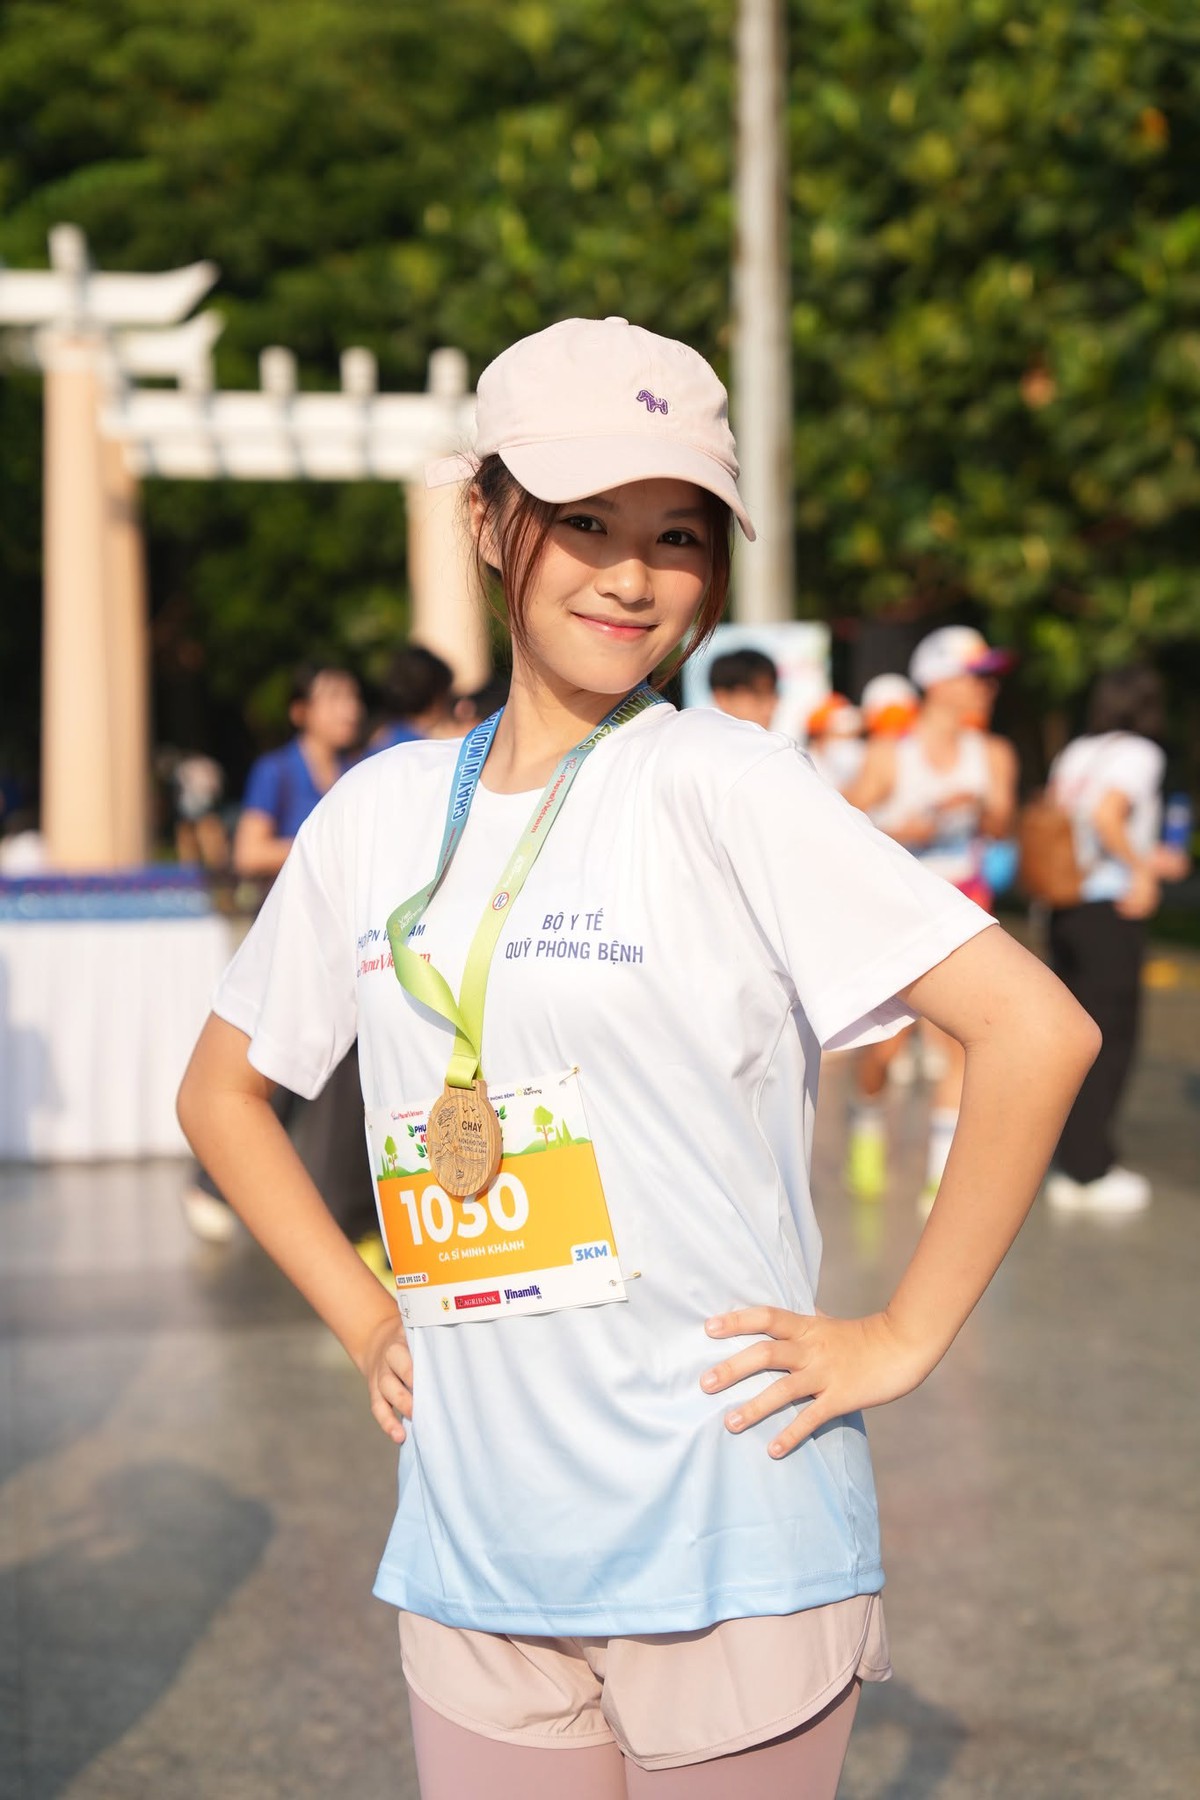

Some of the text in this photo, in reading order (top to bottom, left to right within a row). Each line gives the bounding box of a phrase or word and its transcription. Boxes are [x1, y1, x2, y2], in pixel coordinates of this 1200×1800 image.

[466, 731, 490, 760] MÔI
[459, 761, 480, 779] VÌ
[452, 780, 475, 820] CHẠY
[542, 908, 604, 933] BỘ Y TẾ
[505, 937, 644, 965] QUỸ PHÒNG BỆNH
[400, 1172, 530, 1246] 1030
[438, 1251, 450, 1262] CA
[461, 1246, 486, 1259] MINH
[487, 1239, 525, 1255] KHÁNH
[575, 1244, 608, 1262] 3KM
[463, 1295, 497, 1306] AGRIBANK
[504, 1284, 541, 1300] Vinamilk
